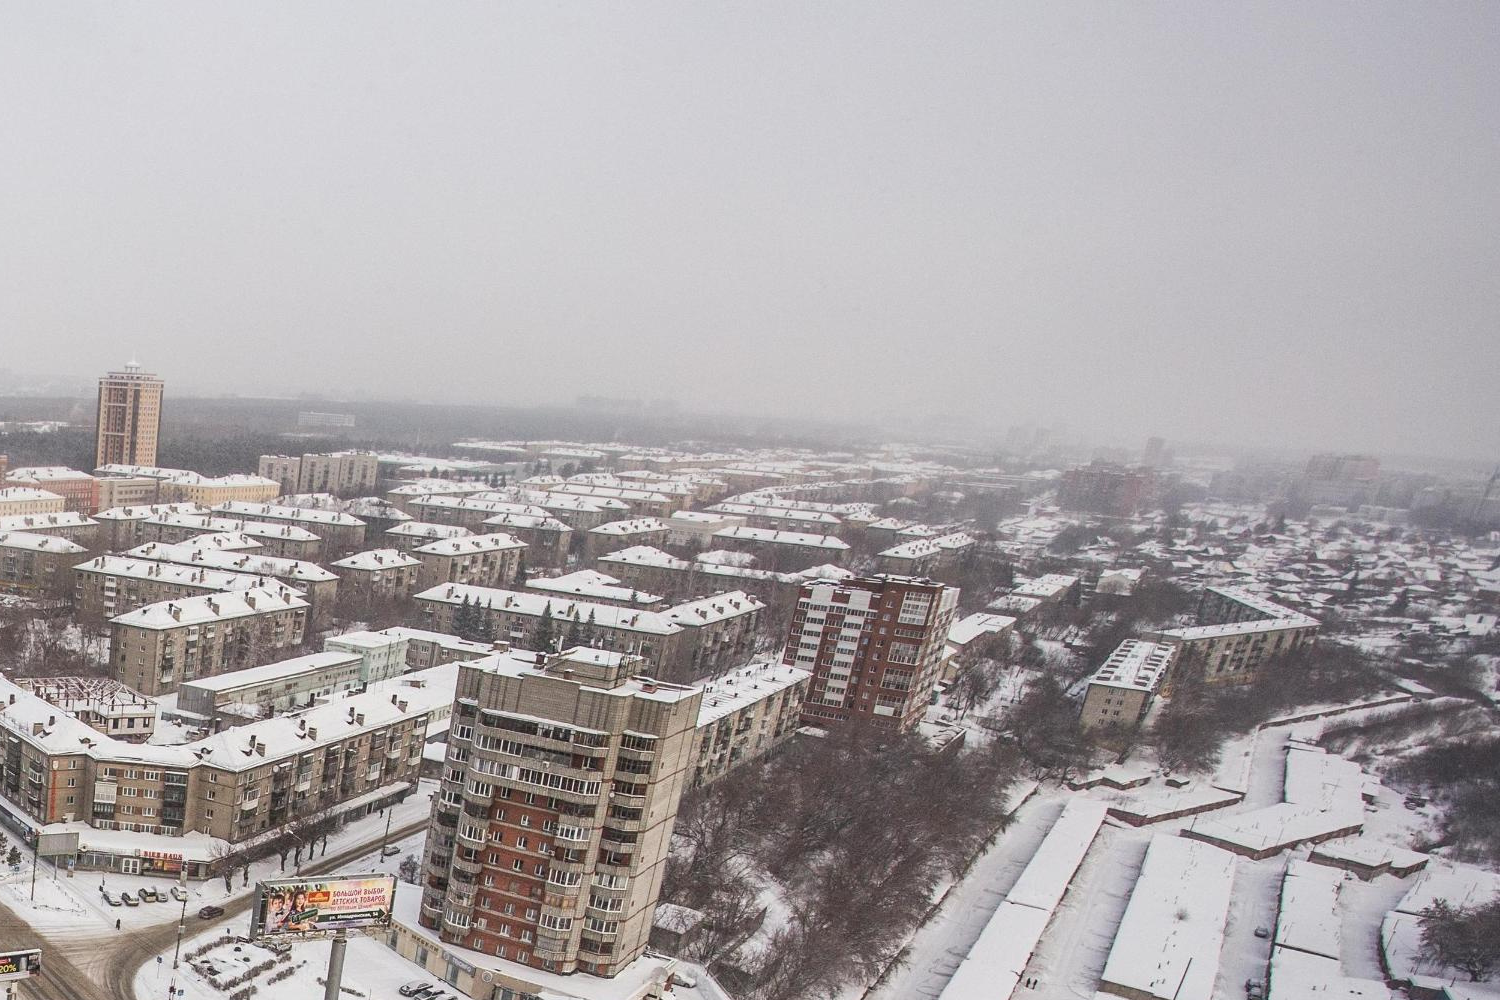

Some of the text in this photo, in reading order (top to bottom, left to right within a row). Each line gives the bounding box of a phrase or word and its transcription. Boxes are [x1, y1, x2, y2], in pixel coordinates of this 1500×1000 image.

[143, 851, 160, 859] BIER
[332, 889, 362, 897] БОЛЬШОЙ
[332, 897, 358, 905] ДЕТСКИХ
[360, 895, 385, 903] ТОВАРОВ
